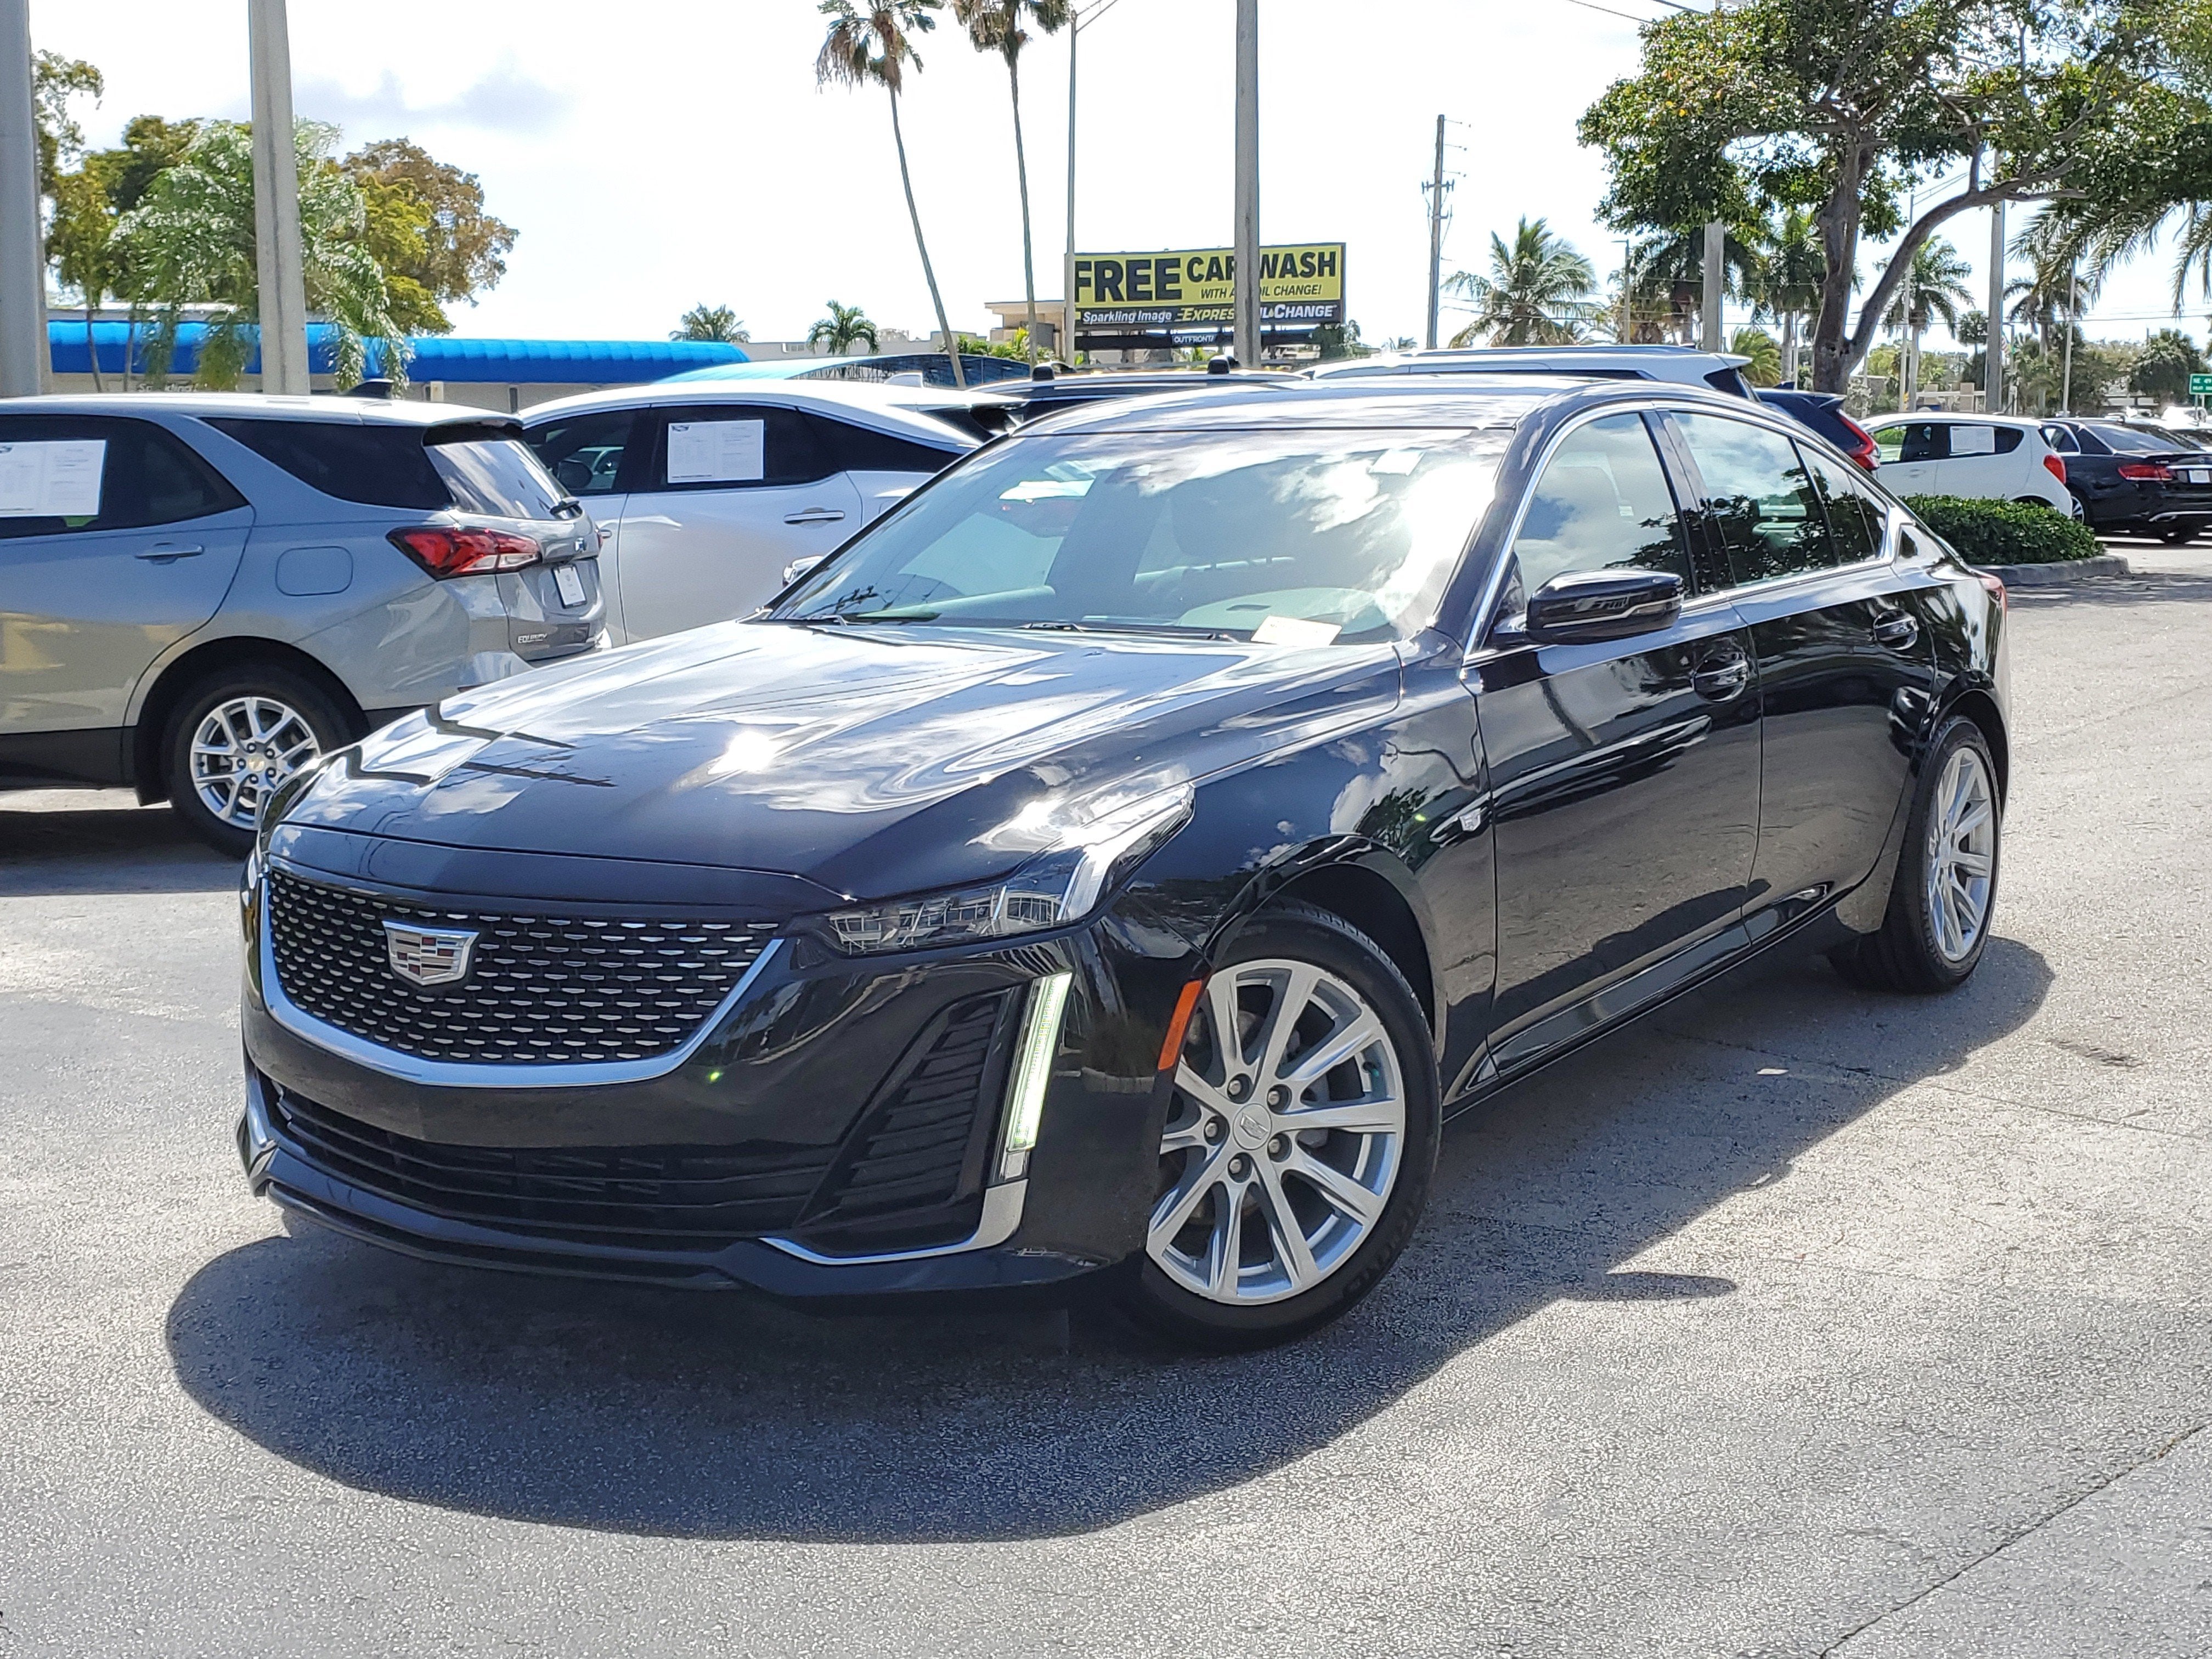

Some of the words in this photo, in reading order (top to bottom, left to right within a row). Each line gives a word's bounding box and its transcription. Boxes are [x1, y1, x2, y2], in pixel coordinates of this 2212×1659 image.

[1075, 258, 1182, 303] FREE
[1260, 251, 1336, 279] WASH
[1201, 287, 1227, 299] WITH
[1260, 286, 1270, 297] IL
[1273, 284, 1322, 296] CHANGE!
[1082, 311, 1136, 325] Sparkling
[1137, 310, 1172, 323] Image
[1182, 307, 1234, 321] EXPRES
[1274, 304, 1333, 319] CHANGE
